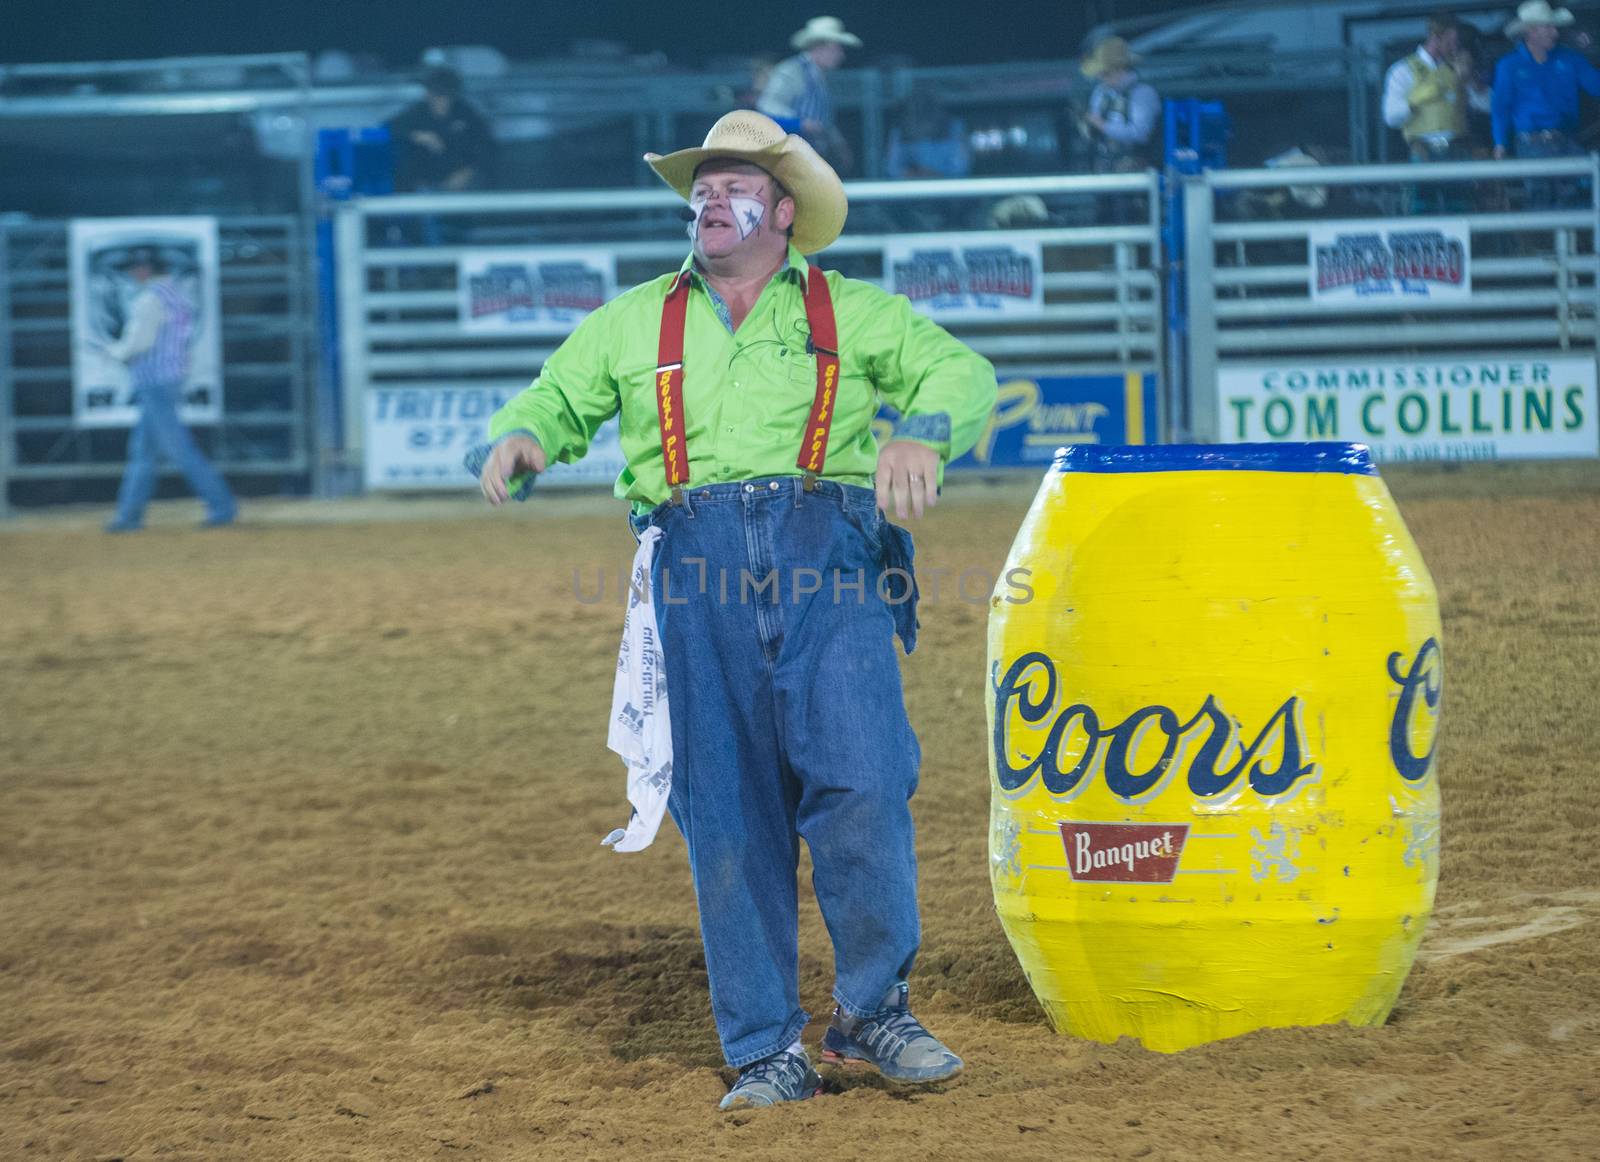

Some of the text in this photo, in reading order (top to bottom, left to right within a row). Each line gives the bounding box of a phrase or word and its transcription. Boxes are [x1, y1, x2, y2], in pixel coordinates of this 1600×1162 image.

[1262, 363, 1552, 391] COMMISSIONER
[1229, 385, 1585, 439] TOM COLLINS
[991, 651, 1320, 801] Coors
[1074, 831, 1174, 875] Banquet
